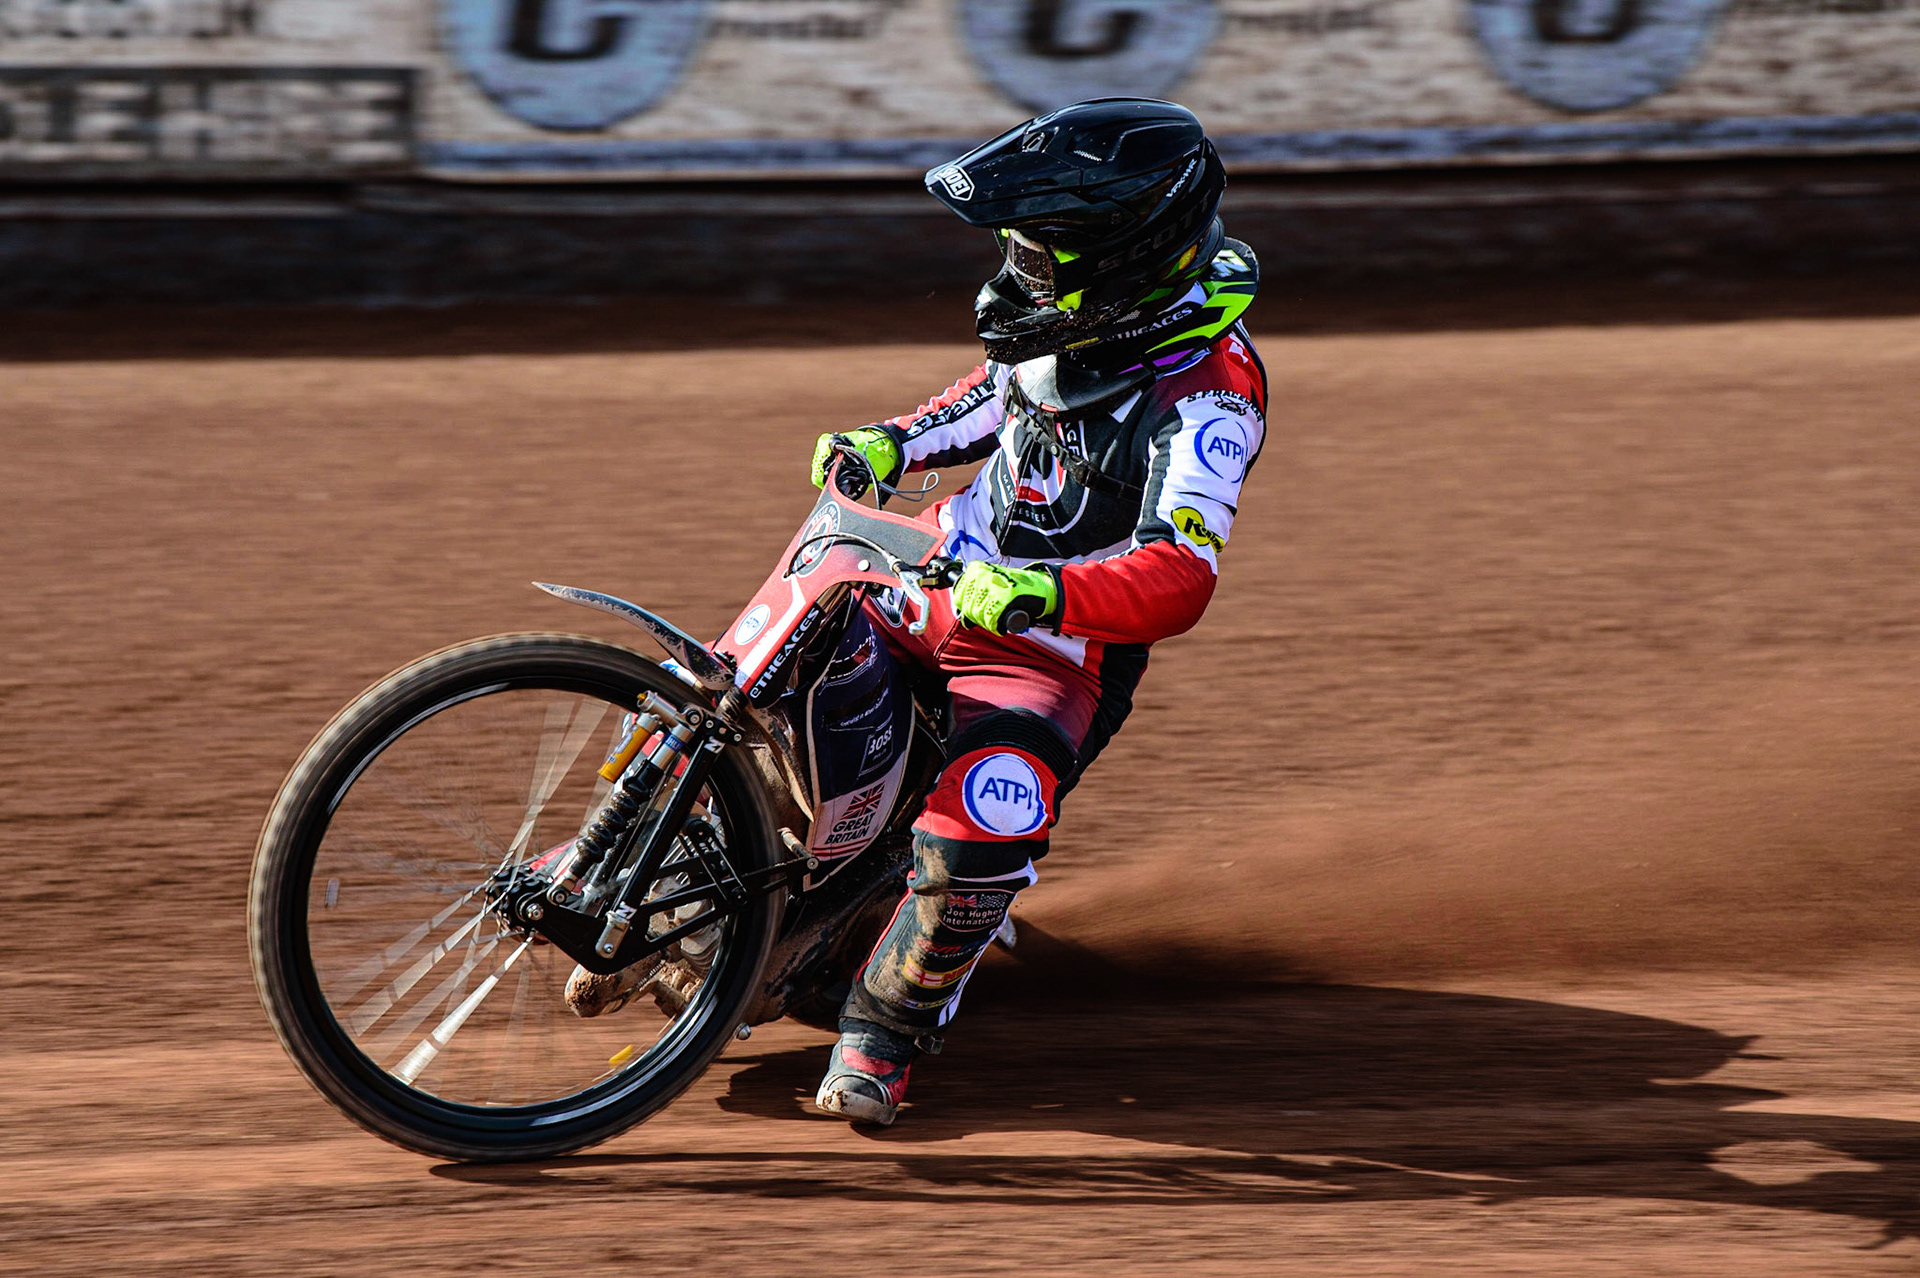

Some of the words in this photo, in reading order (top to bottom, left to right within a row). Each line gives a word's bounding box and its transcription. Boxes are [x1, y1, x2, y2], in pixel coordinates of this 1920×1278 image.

[1206, 436, 1246, 465] ATPI
[978, 777, 1033, 811] ATPI
[832, 812, 876, 833] GREAT
[824, 826, 870, 845] BRITAIN
[946, 907, 965, 918] Joe
